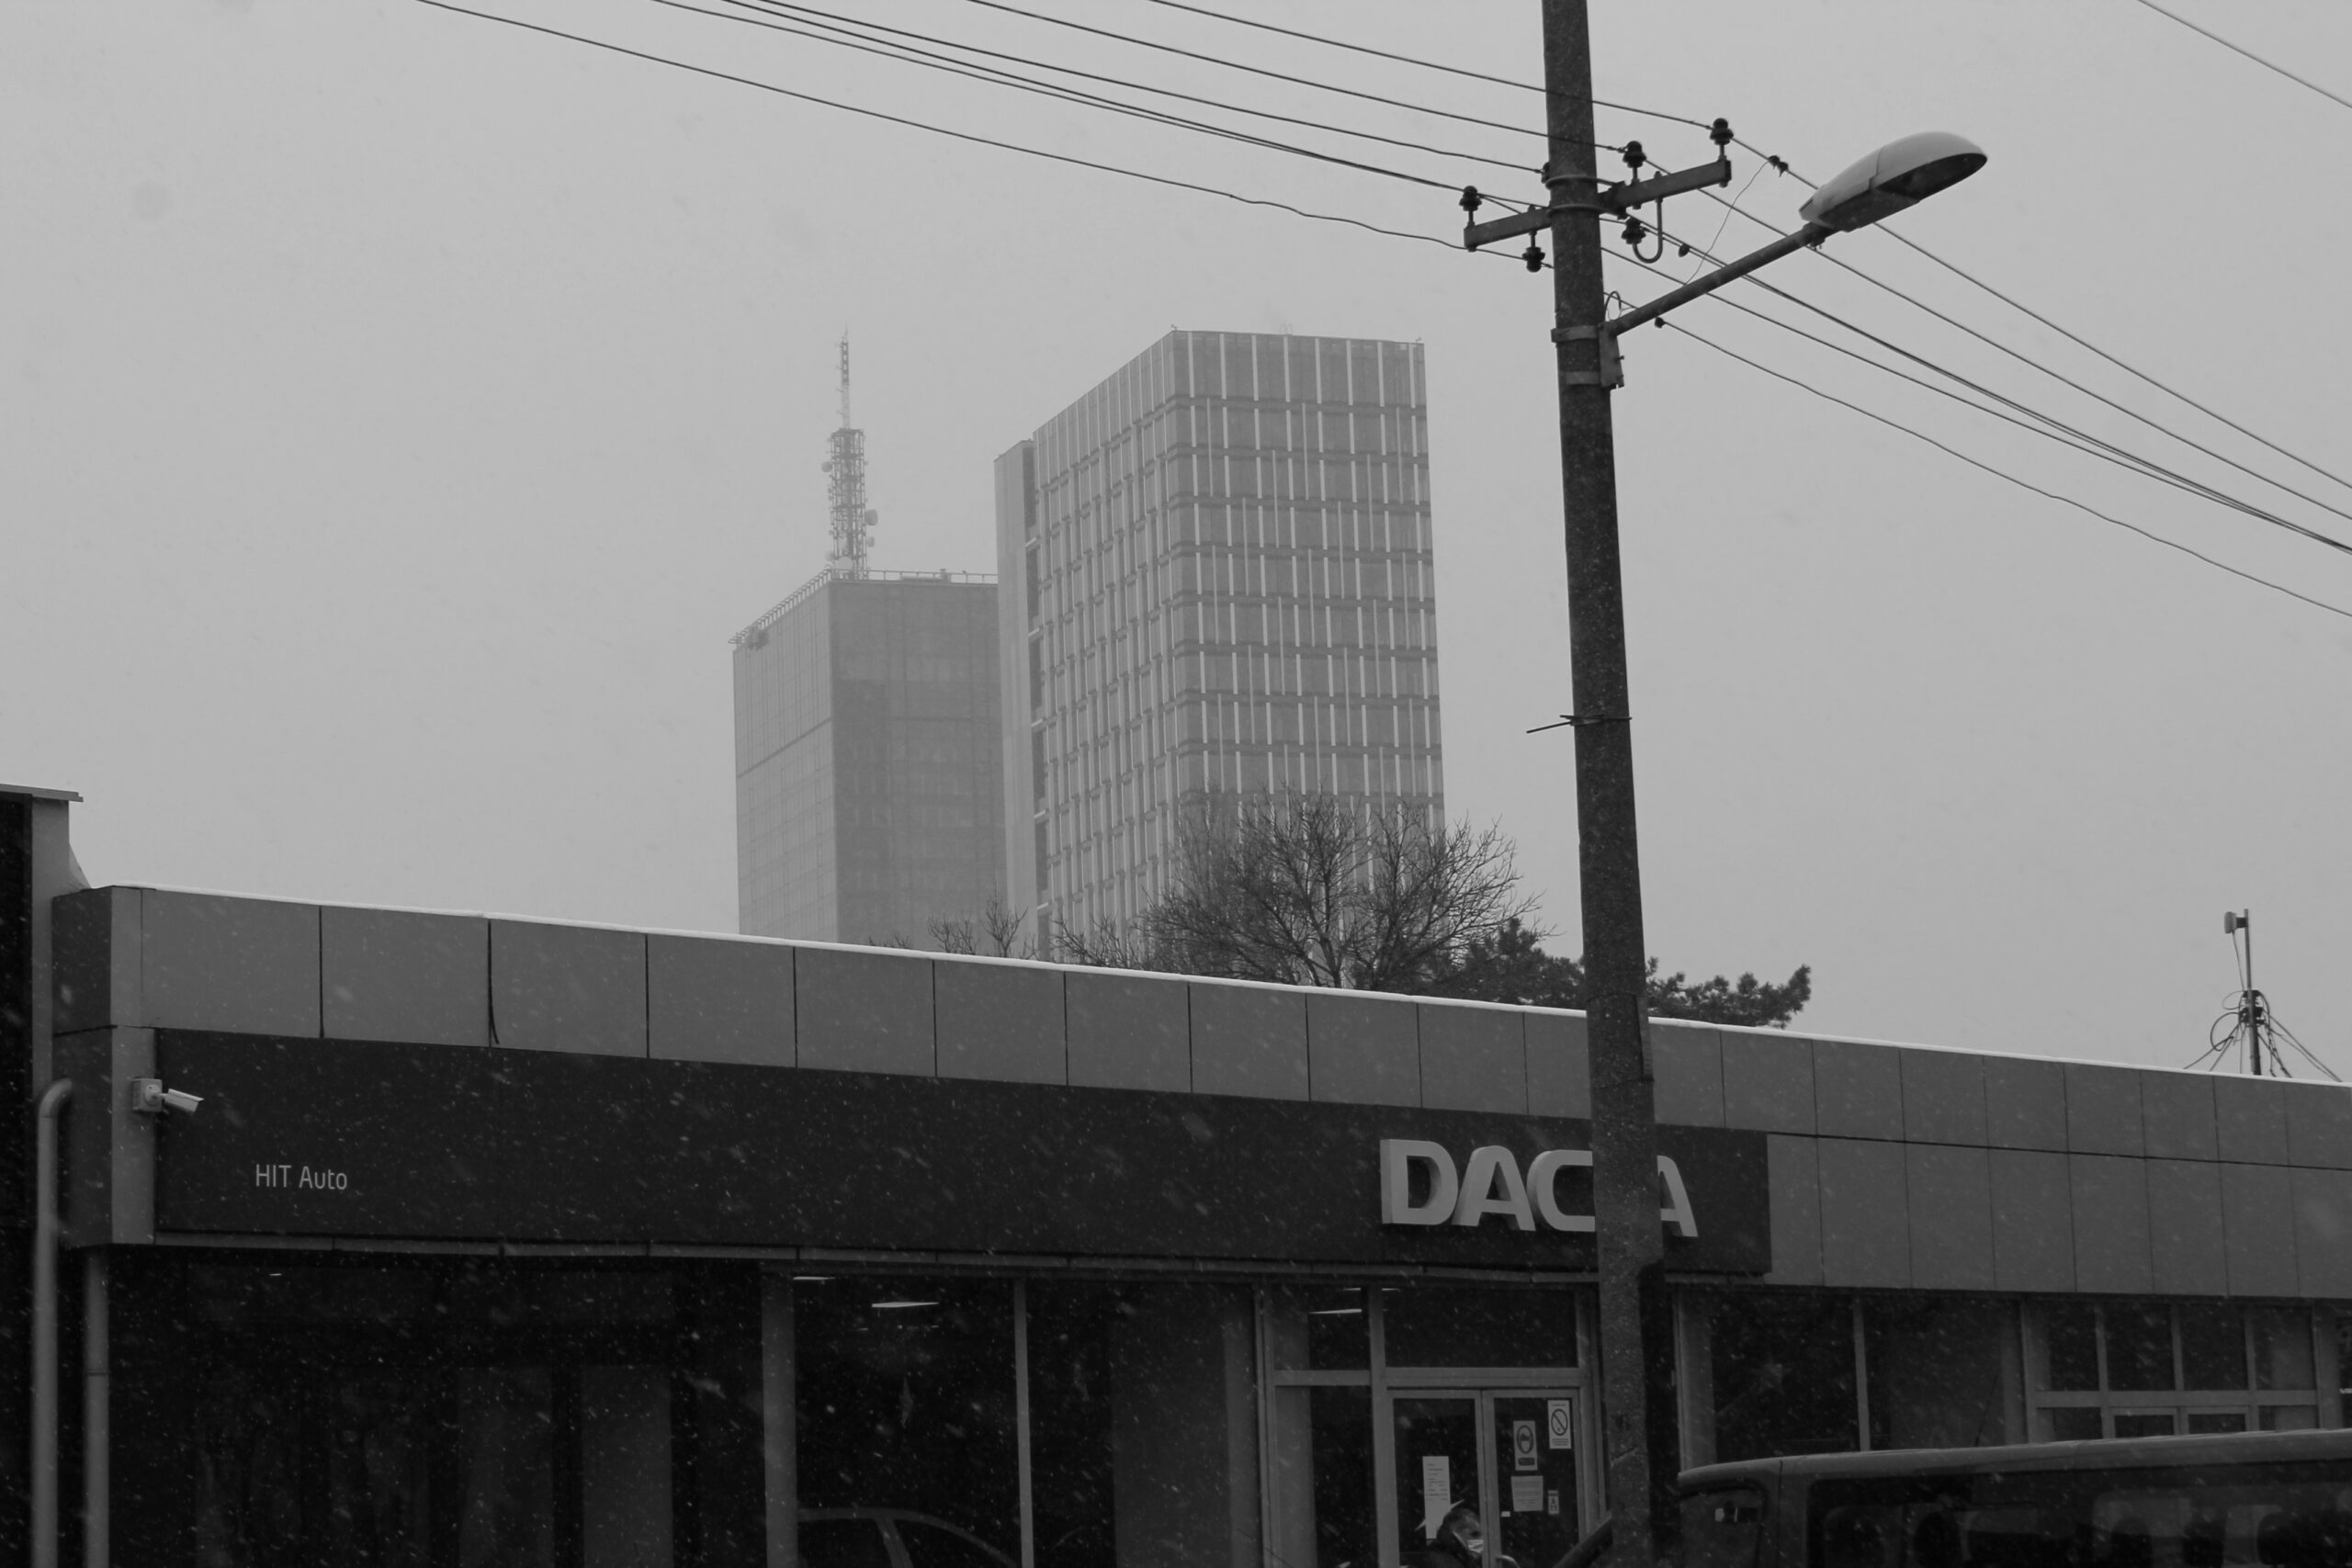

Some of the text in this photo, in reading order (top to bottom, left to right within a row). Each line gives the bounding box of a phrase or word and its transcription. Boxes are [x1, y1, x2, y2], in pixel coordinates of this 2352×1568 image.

[255, 1164, 347, 1190] HIT Auto
[1380, 1138, 1698, 1237] DACA
